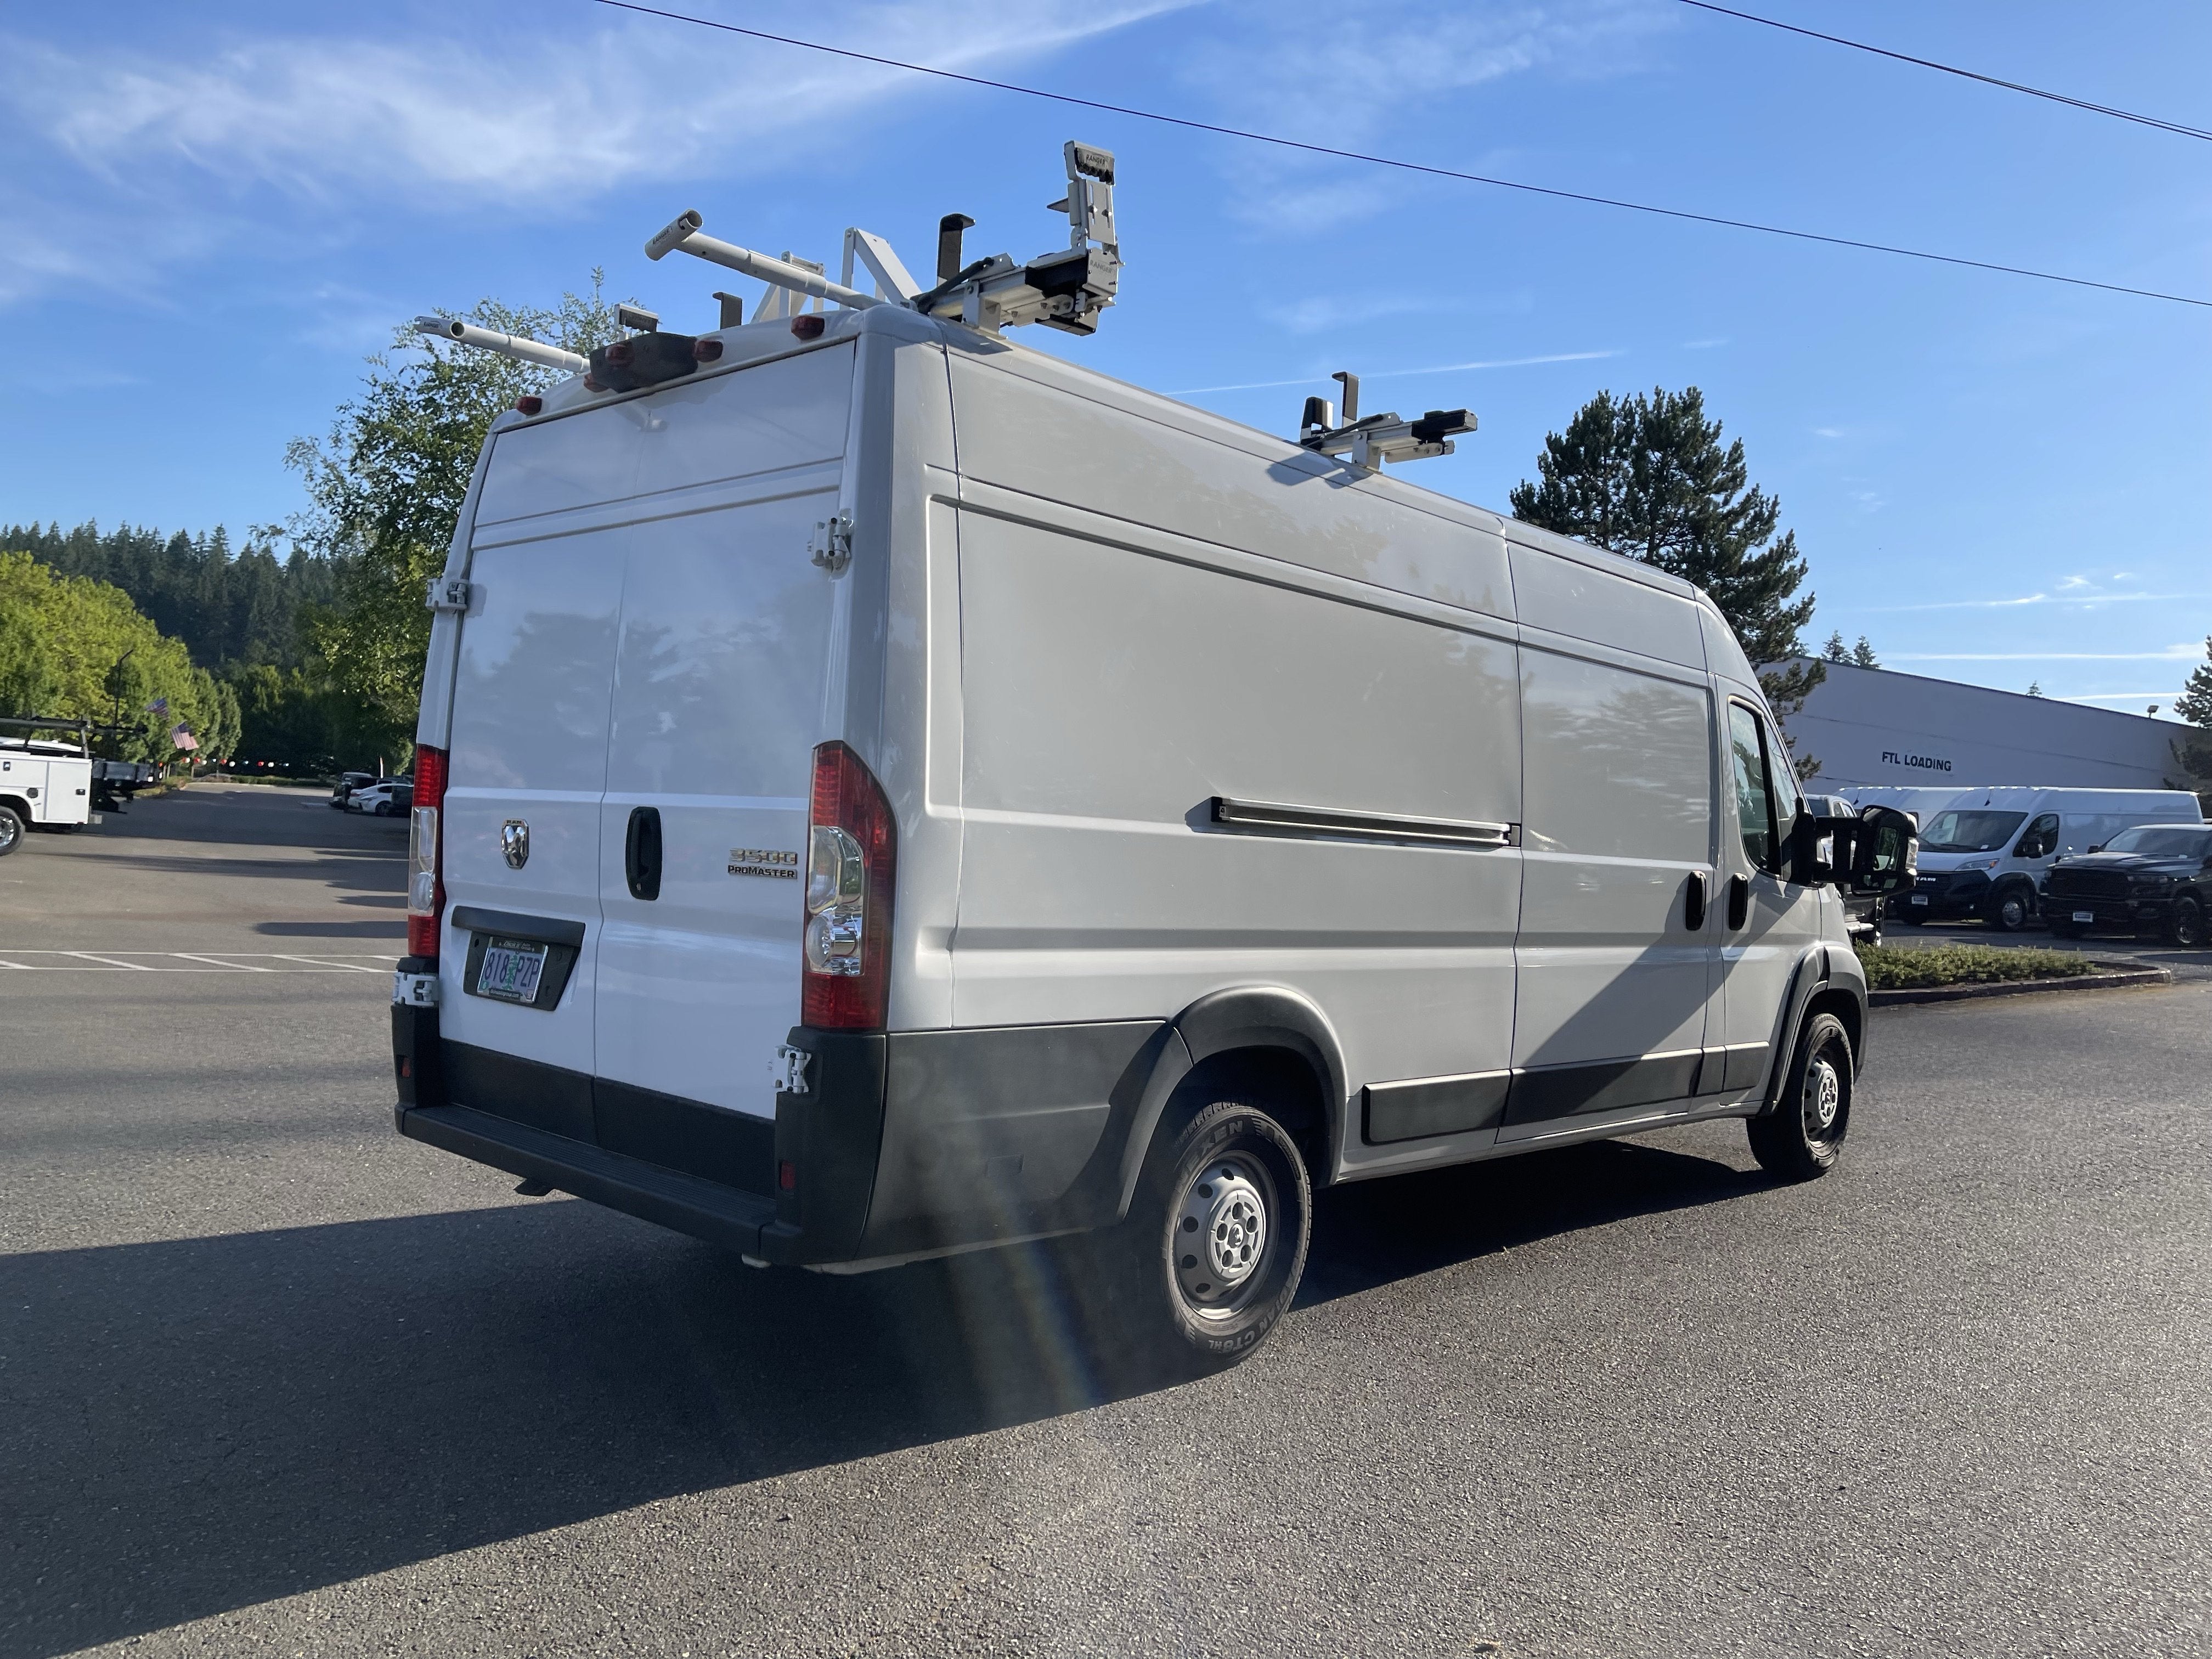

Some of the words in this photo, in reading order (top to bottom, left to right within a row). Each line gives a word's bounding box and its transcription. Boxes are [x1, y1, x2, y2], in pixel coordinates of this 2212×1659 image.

[1086, 154, 1105, 166] RANGER
[1090, 259, 1112, 273] RANGER
[1882, 751, 1900, 764] FTL
[1905, 754, 1951, 771] LOADING
[729, 848, 798, 865] 3500
[728, 865, 795, 878] PROMASTER
[484, 952, 510, 984] 818
[513, 955, 540, 987] PZP
[1175, 1120, 1243, 1194] NEXEN
